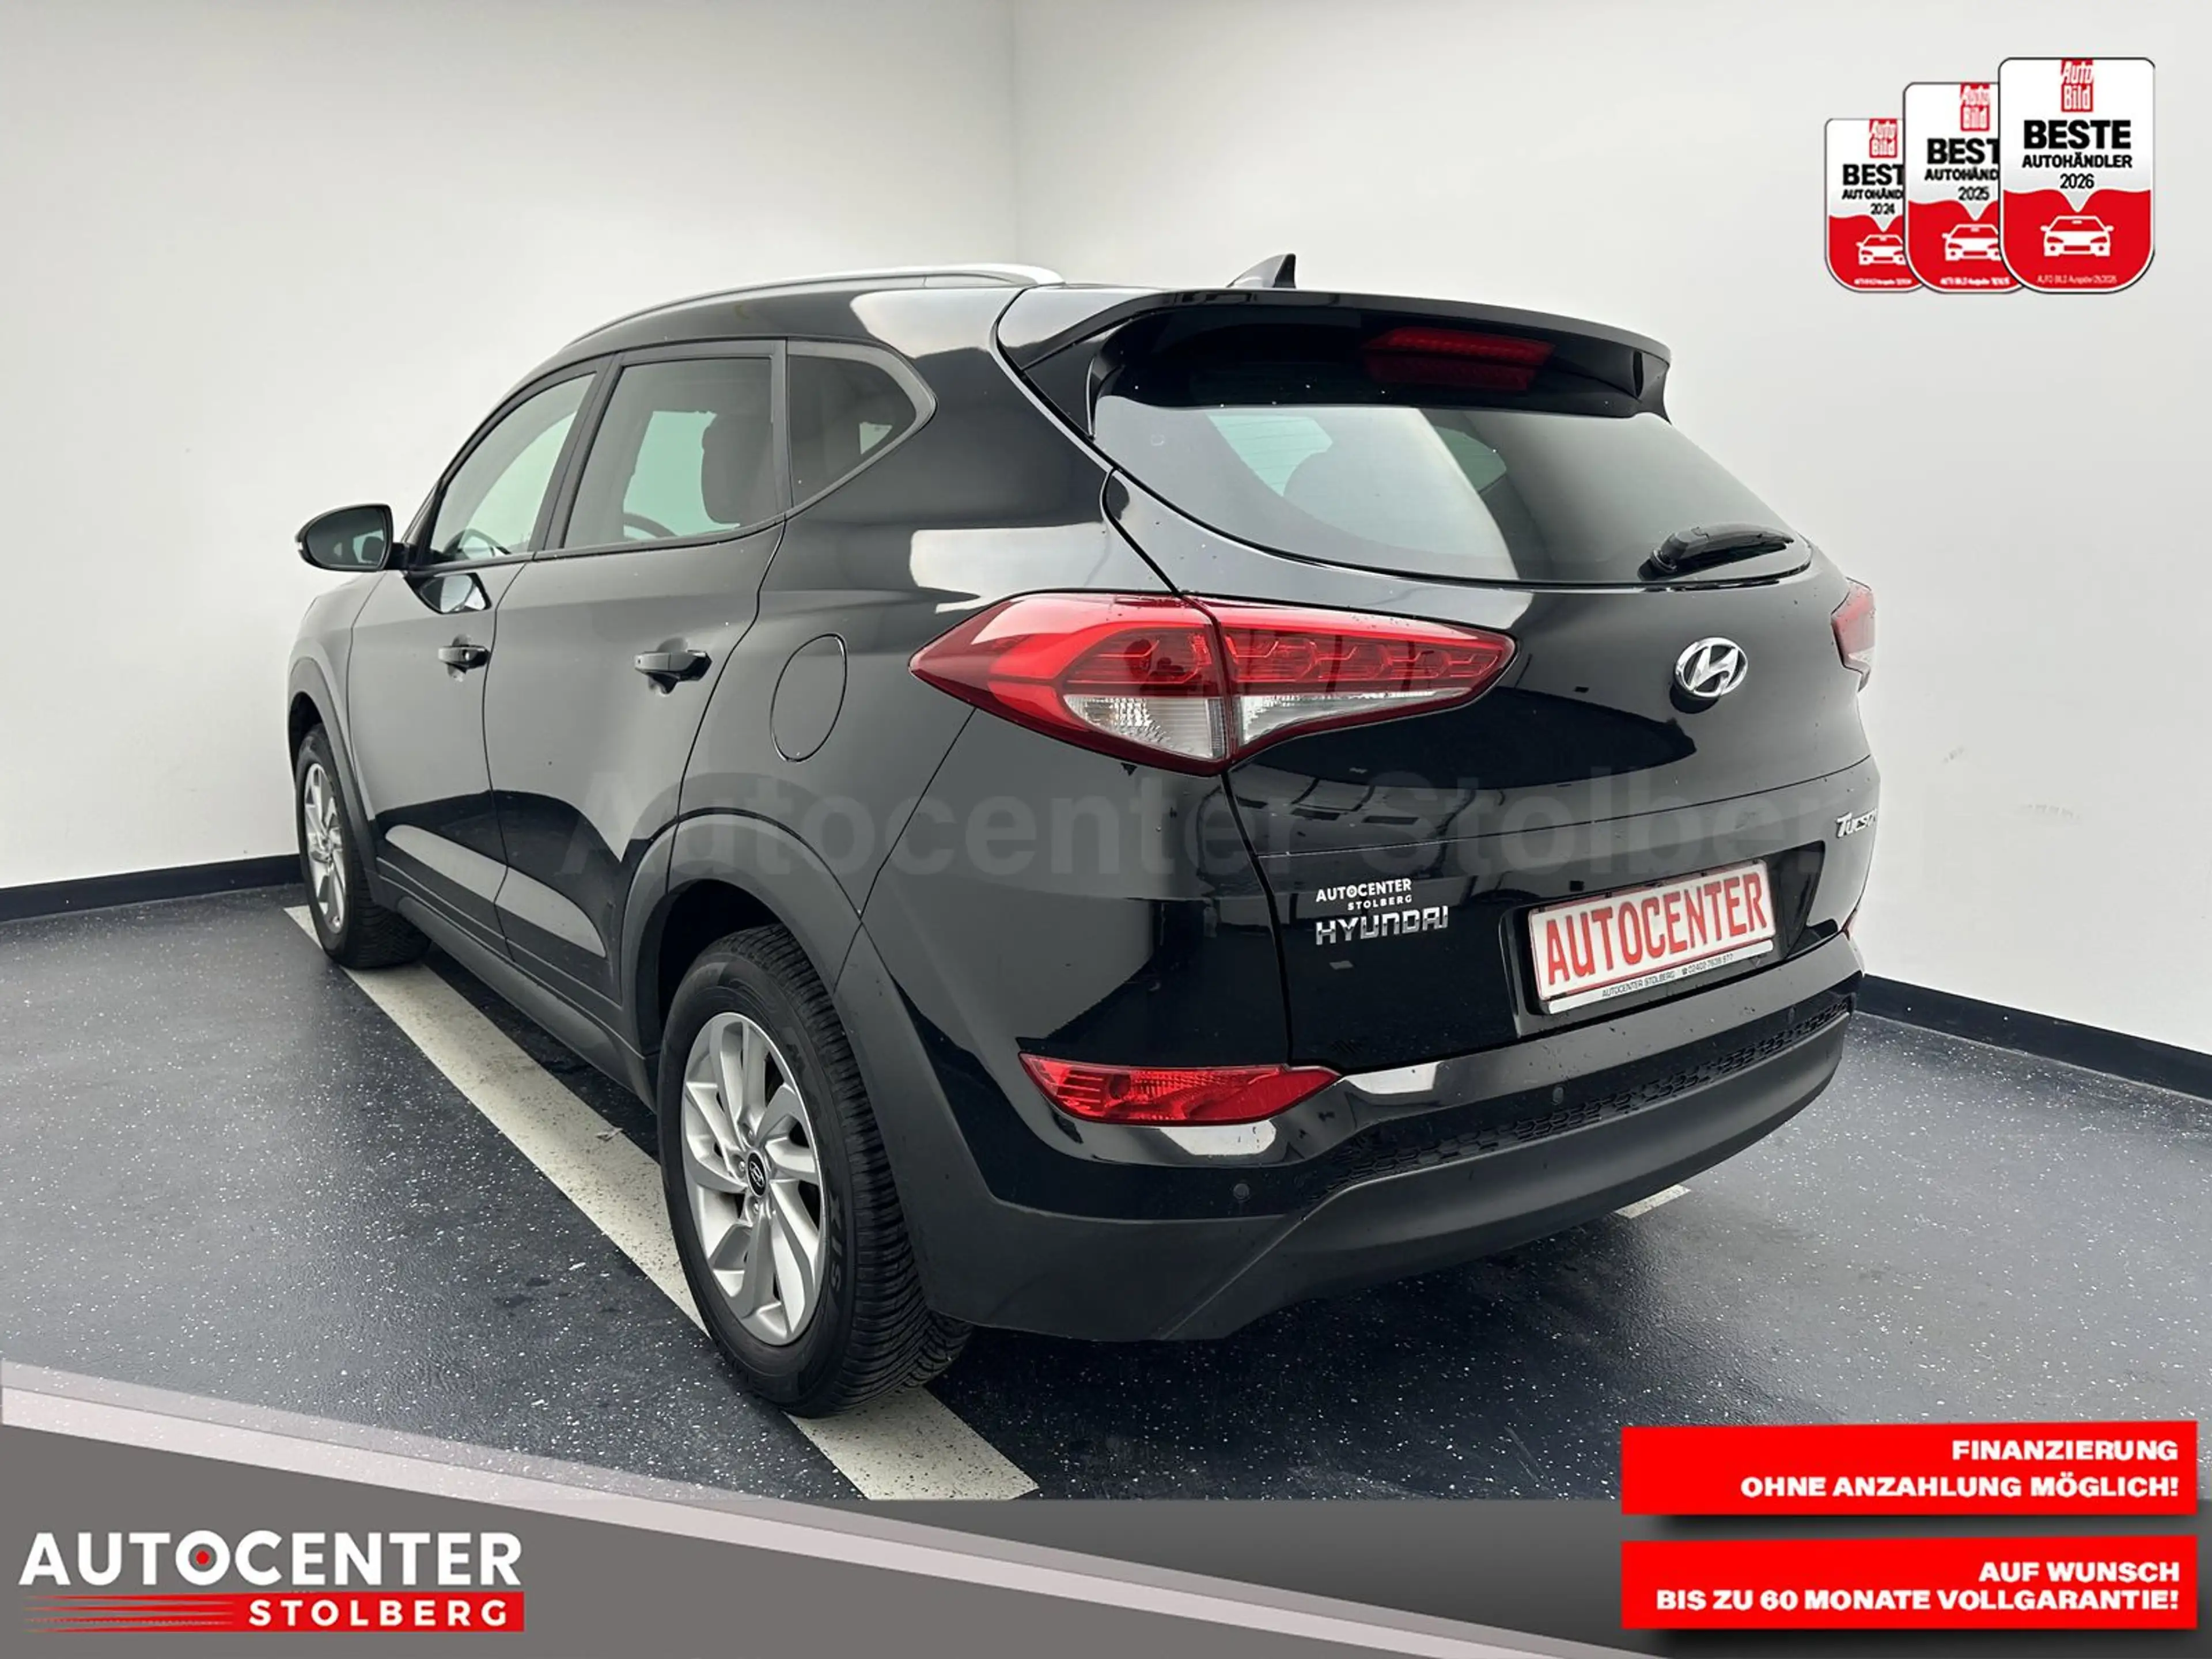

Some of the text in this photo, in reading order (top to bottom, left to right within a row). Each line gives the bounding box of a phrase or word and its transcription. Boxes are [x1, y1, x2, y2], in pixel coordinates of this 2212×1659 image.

[1316, 878, 1412, 903] AUTOCENTER
[1347, 894, 1412, 911] STOLBERG
[1316, 905, 1448, 945] HYUNDAI
[1547, 872, 1767, 986] AUTOCENTER
